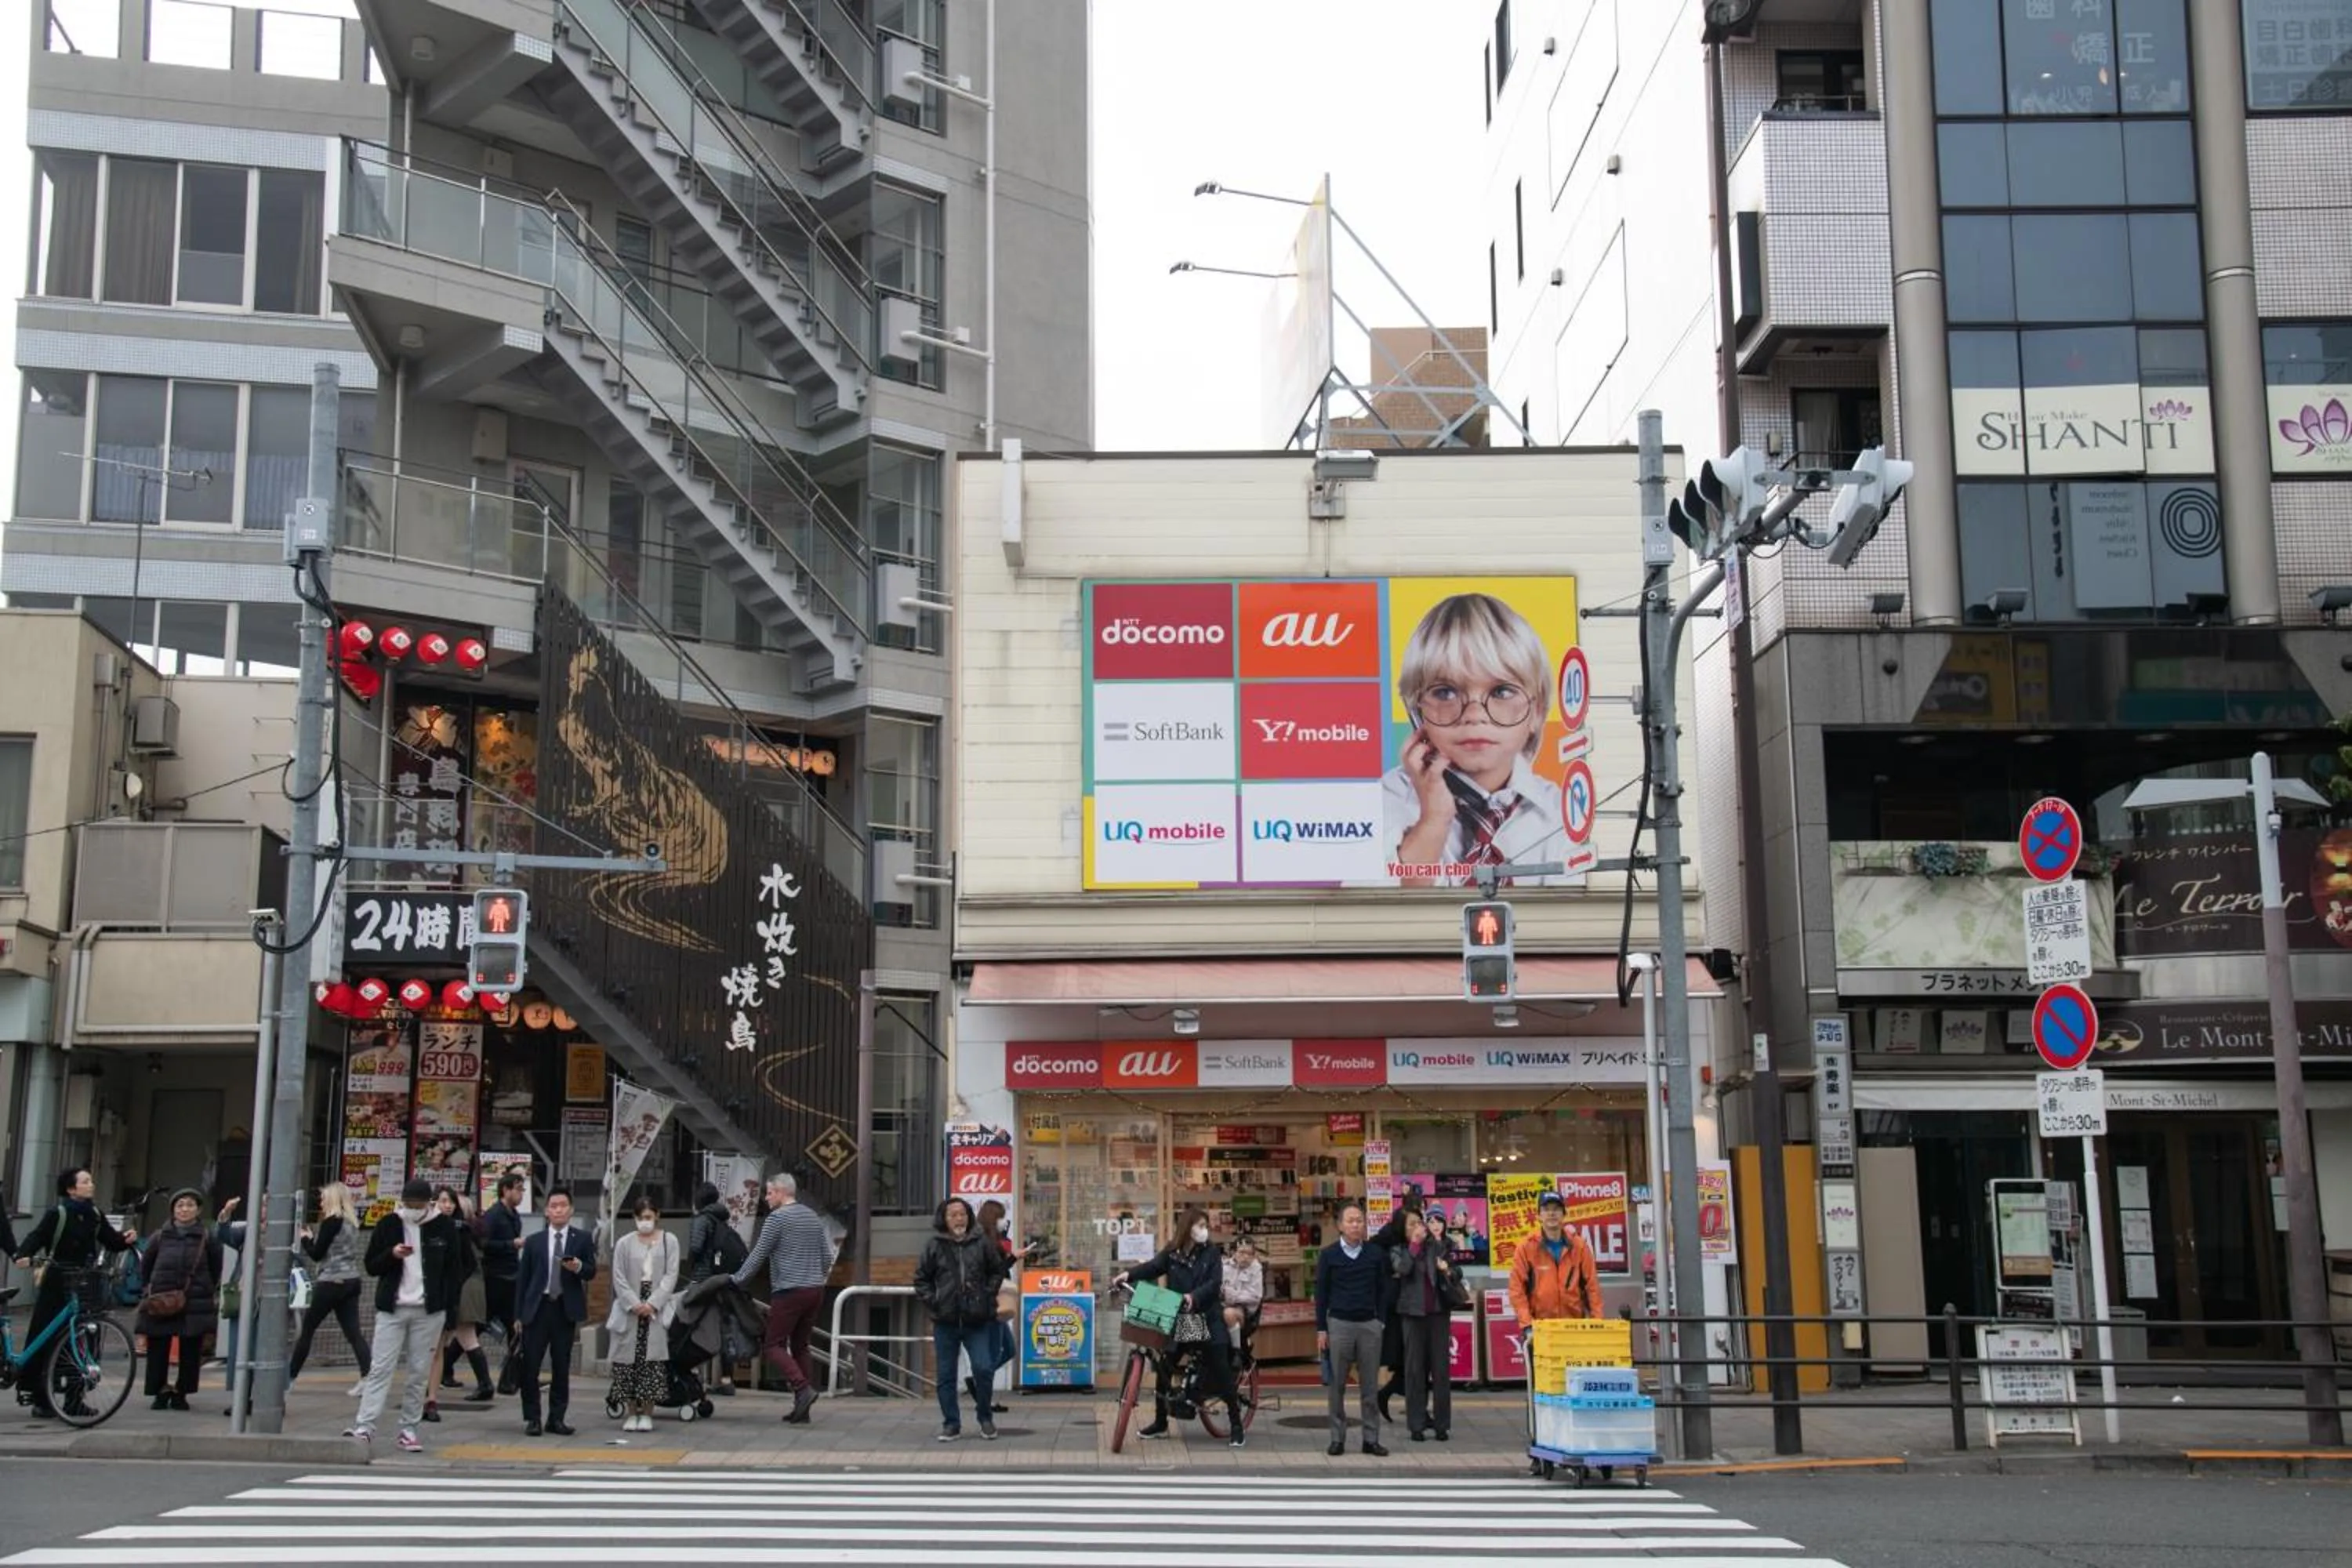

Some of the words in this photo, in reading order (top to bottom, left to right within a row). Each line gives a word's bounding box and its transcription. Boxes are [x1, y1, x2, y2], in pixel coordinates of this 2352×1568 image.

[2071, 31, 2155, 64] 矯正
[1976, 411, 2178, 450] SHANTI
[1102, 619, 1225, 644] docomo
[1261, 612, 1354, 647] au
[1564, 669, 1582, 706] 40
[1134, 722, 1225, 742] SoftBank
[1252, 719, 1294, 742] Y!
[1298, 724, 1370, 742] mobile
[1104, 821, 1143, 844] UQ
[1149, 822, 1225, 839] mobile
[1254, 820, 1292, 844] UQ
[1297, 822, 1374, 839] WiMAX
[2132, 848, 2181, 861] フレンチ
[2187, 844, 2252, 859] ワインバー
[1388, 863, 1413, 877] You
[1417, 864, 1442, 877] can
[1445, 862, 1475, 877] cho
[2170, 873, 2303, 914] Terror
[757, 864, 801, 989] 水炊き
[1922, 972, 2005, 993] プラネット
[721, 964, 763, 1052] 焼鳥
[424, 1033, 477, 1051] ランチ
[2161, 1029, 2190, 1049] Le
[1013, 1055, 1098, 1074] docomo
[1118, 1051, 1183, 1076] au
[1225, 1056, 1287, 1069] SoftBank
[1332, 1057, 1374, 1069] mobile
[1392, 1052, 1420, 1069] UQ
[1423, 1052, 1475, 1065] mobile
[1486, 1051, 1514, 1067] UQ
[1516, 1051, 1570, 1065] WiMAX
[1581, 1051, 1639, 1066] プリペイド
[950, 1133, 996, 1146] 全キャリア
[954, 1152, 1010, 1166] docomo
[959, 1172, 1007, 1192] au
[1559, 1180, 1622, 1200] iPhone8
[1490, 1185, 1554, 1205] festiv
[1038, 1275, 1073, 1289] au
